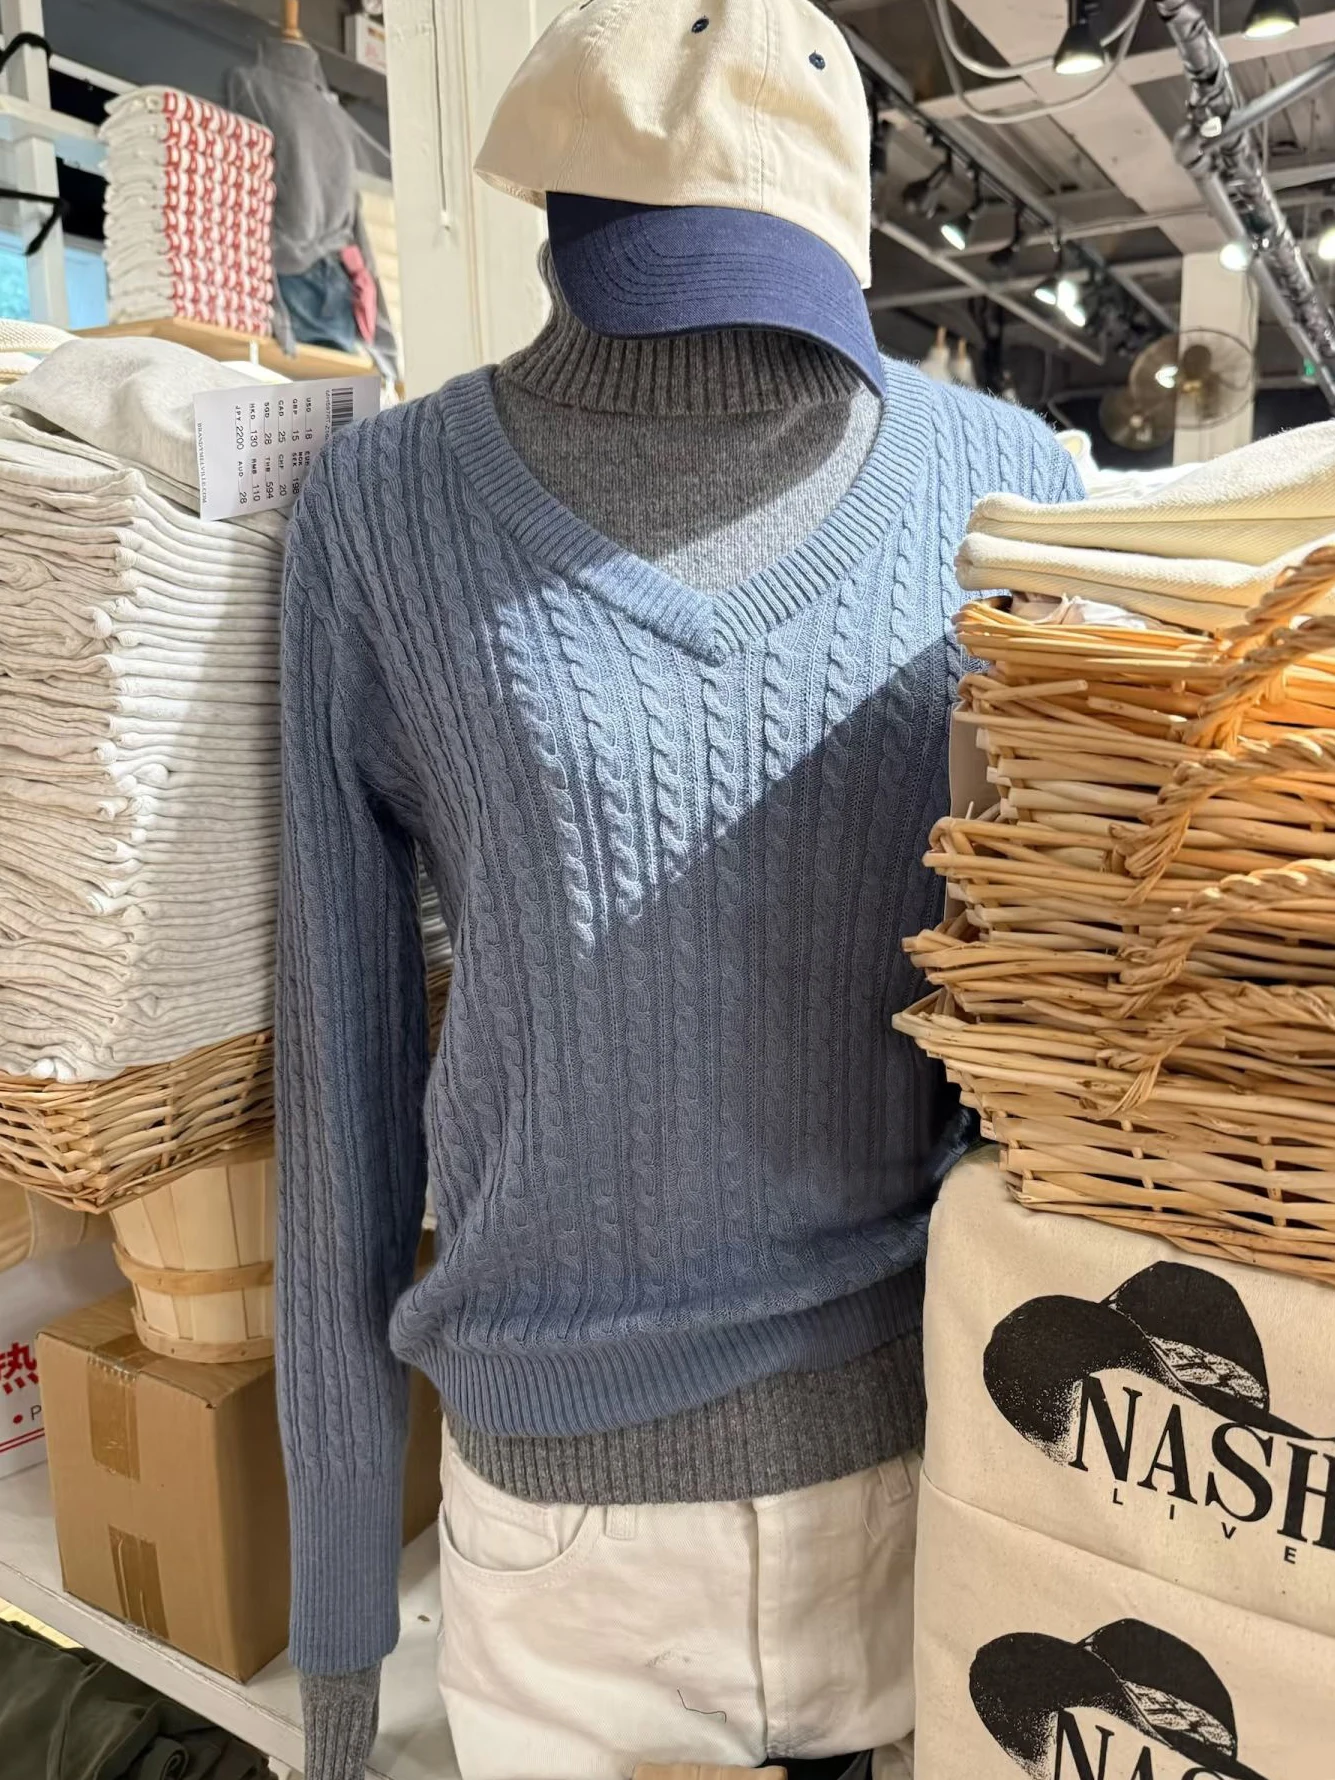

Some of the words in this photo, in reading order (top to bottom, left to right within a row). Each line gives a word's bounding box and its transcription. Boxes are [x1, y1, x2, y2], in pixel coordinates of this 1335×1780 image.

[236, 425, 244, 450] 2200
[250, 430, 258, 448] 130
[264, 432, 272, 445] 28
[279, 430, 286, 443] 25
[291, 429, 300, 442] 15
[305, 428, 313, 440] 18
[252, 484, 260, 502] 110
[265, 481, 274, 499] 594
[279, 484, 287, 497] 20
[292, 477, 300, 495] 198
[240, 491, 247, 504] 28
[1068, 1375, 1335, 1552] NASH
[1112, 1487, 1298, 1565] LIVE
